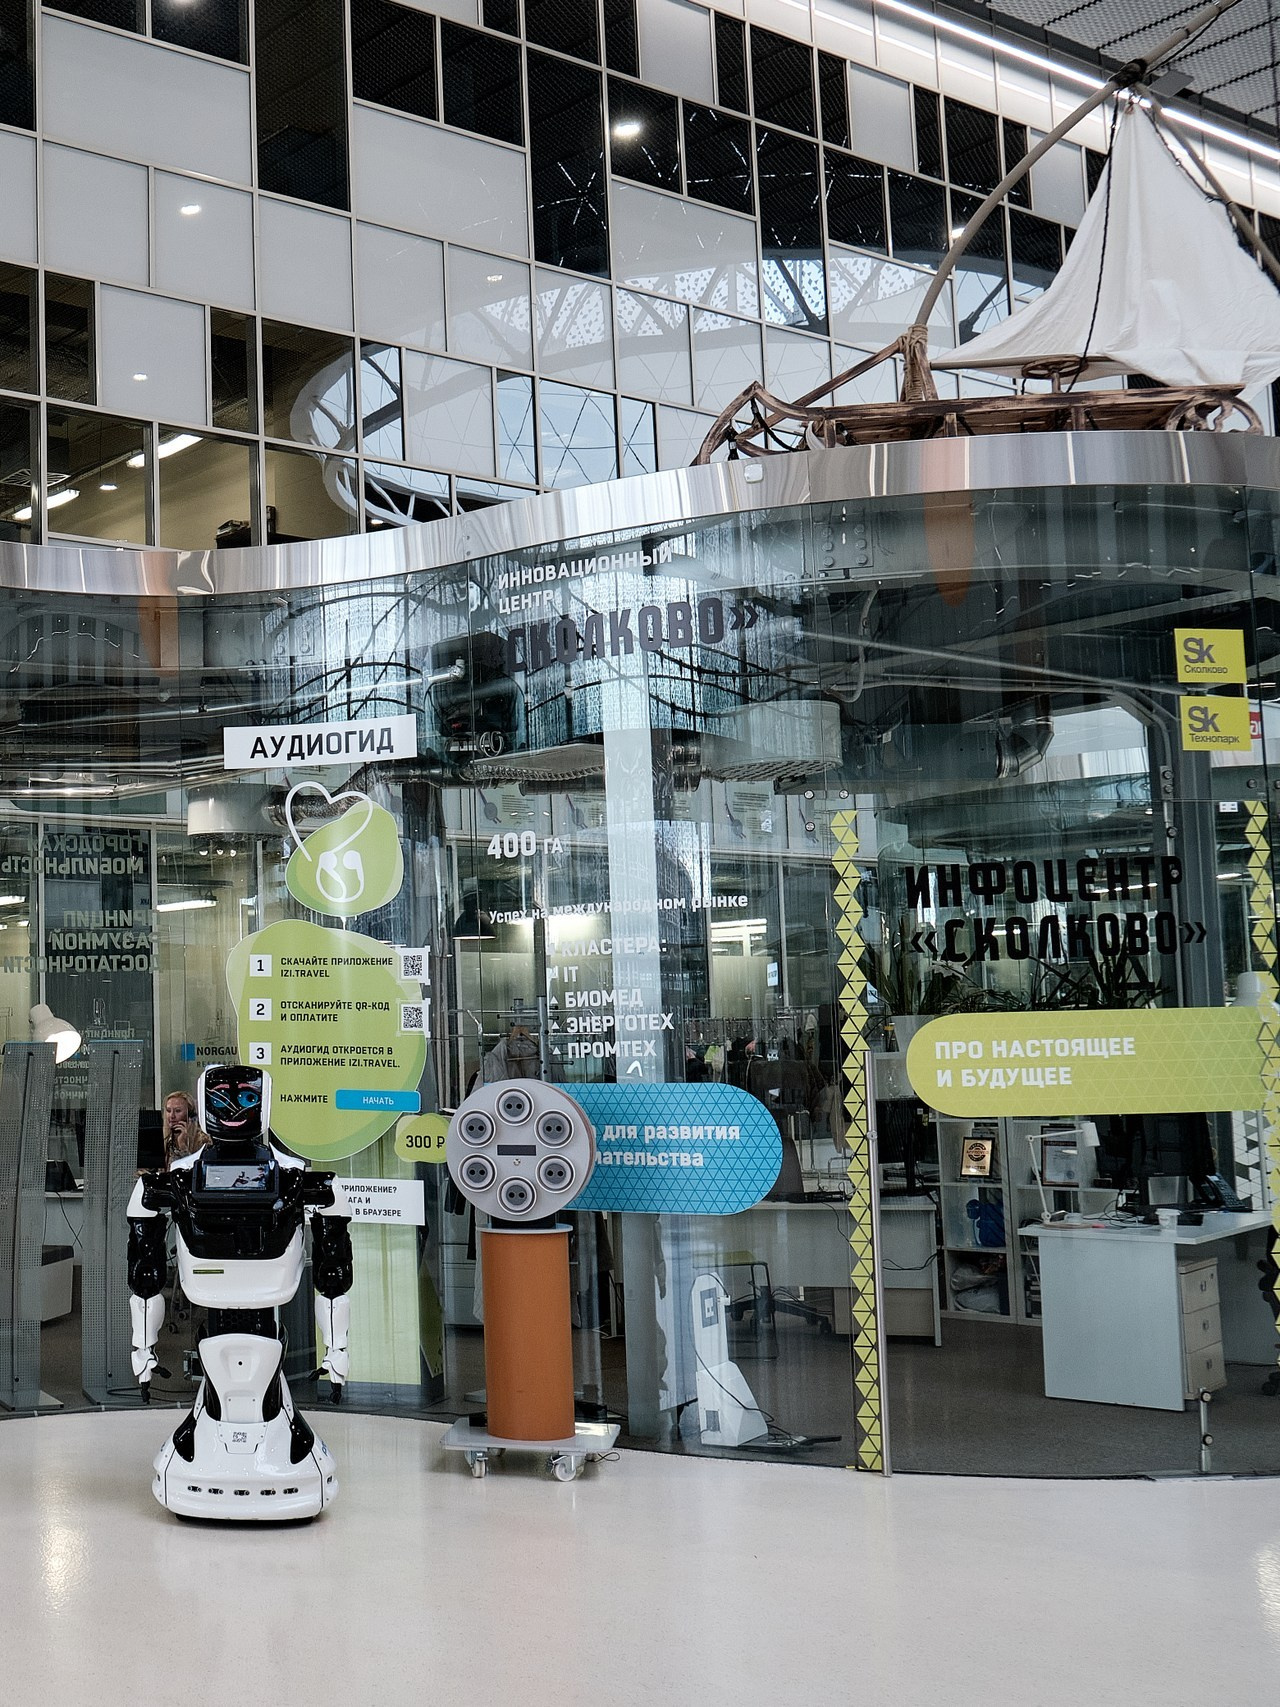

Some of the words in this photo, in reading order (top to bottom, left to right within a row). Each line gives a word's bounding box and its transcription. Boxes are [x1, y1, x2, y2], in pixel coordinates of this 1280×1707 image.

[498, 547, 671, 590] ИННОВАЦИОННЫЙ
[499, 590, 554, 614] ЦЕНТР
[1183, 637, 1216, 664] Sk
[1184, 664, 1228, 674] Сколково
[1188, 706, 1220, 733] Sk
[250, 727, 394, 761] АУДИОГИД
[1189, 733, 1240, 744] Технопарк
[487, 830, 536, 860] 400
[905, 855, 1183, 909] ИНФОЦЕНТР
[489, 908, 527, 925] Успех
[531, 907, 548, 920] на
[552, 898, 686, 916] международном
[691, 894, 748, 913] рынке
[910, 912, 1207, 963] «СКОЛКОВО»
[562, 936, 667, 957] КЛАСТЕРА:
[256, 959, 265, 971] 1
[280, 956, 328, 967] СКАЧАЙТЕ
[331, 956, 393, 967] ПРИЛОЖЕНИЕ
[280, 969, 330, 978] IZI.TRAVEL
[563, 966, 578, 982] IT
[280, 999, 353, 1010] ОТСКАНИРУЙТЕ
[355, 1001, 390, 1012] QR-КОД
[564, 988, 644, 1008] БИОМЕД
[256, 1003, 265, 1016] 2
[280, 1012, 286, 1021] И
[289, 1012, 338, 1022] ОПЛАТИТЕ
[566, 1013, 675, 1033] ЭНЕРГОТЕХ
[196, 1046, 238, 1056] NORGAU
[256, 1048, 265, 1059] 3
[280, 1045, 330, 1056] АУДИОГИД
[332, 1045, 385, 1055] ОТКРОЕТСЯ
[388, 1046, 393, 1055] В
[567, 1039, 657, 1058] ПРОМТЕХ
[935, 1041, 983, 1060] ПРО
[992, 1037, 1136, 1059] НАСТОЯЩЕЕ
[280, 1057, 345, 1067] ПРИЛОЖЕНИЕ
[348, 1058, 400, 1068] IZI.TRAVEL.
[936, 1069, 952, 1087] И
[961, 1066, 1072, 1089] БУДУЩЕЕ
[280, 1094, 328, 1104] НАЖМИТЕ
[362, 1096, 394, 1106] НАЧАТЬ
[405, 1135, 432, 1149] 300
[602, 1125, 637, 1141] для
[644, 1125, 740, 1144] развития
[346, 1196, 363, 1205] АГА
[366, 1196, 371, 1204] И
[355, 1208, 361, 1216] В
[363, 1208, 402, 1217] БРАУЗЕРЕ
